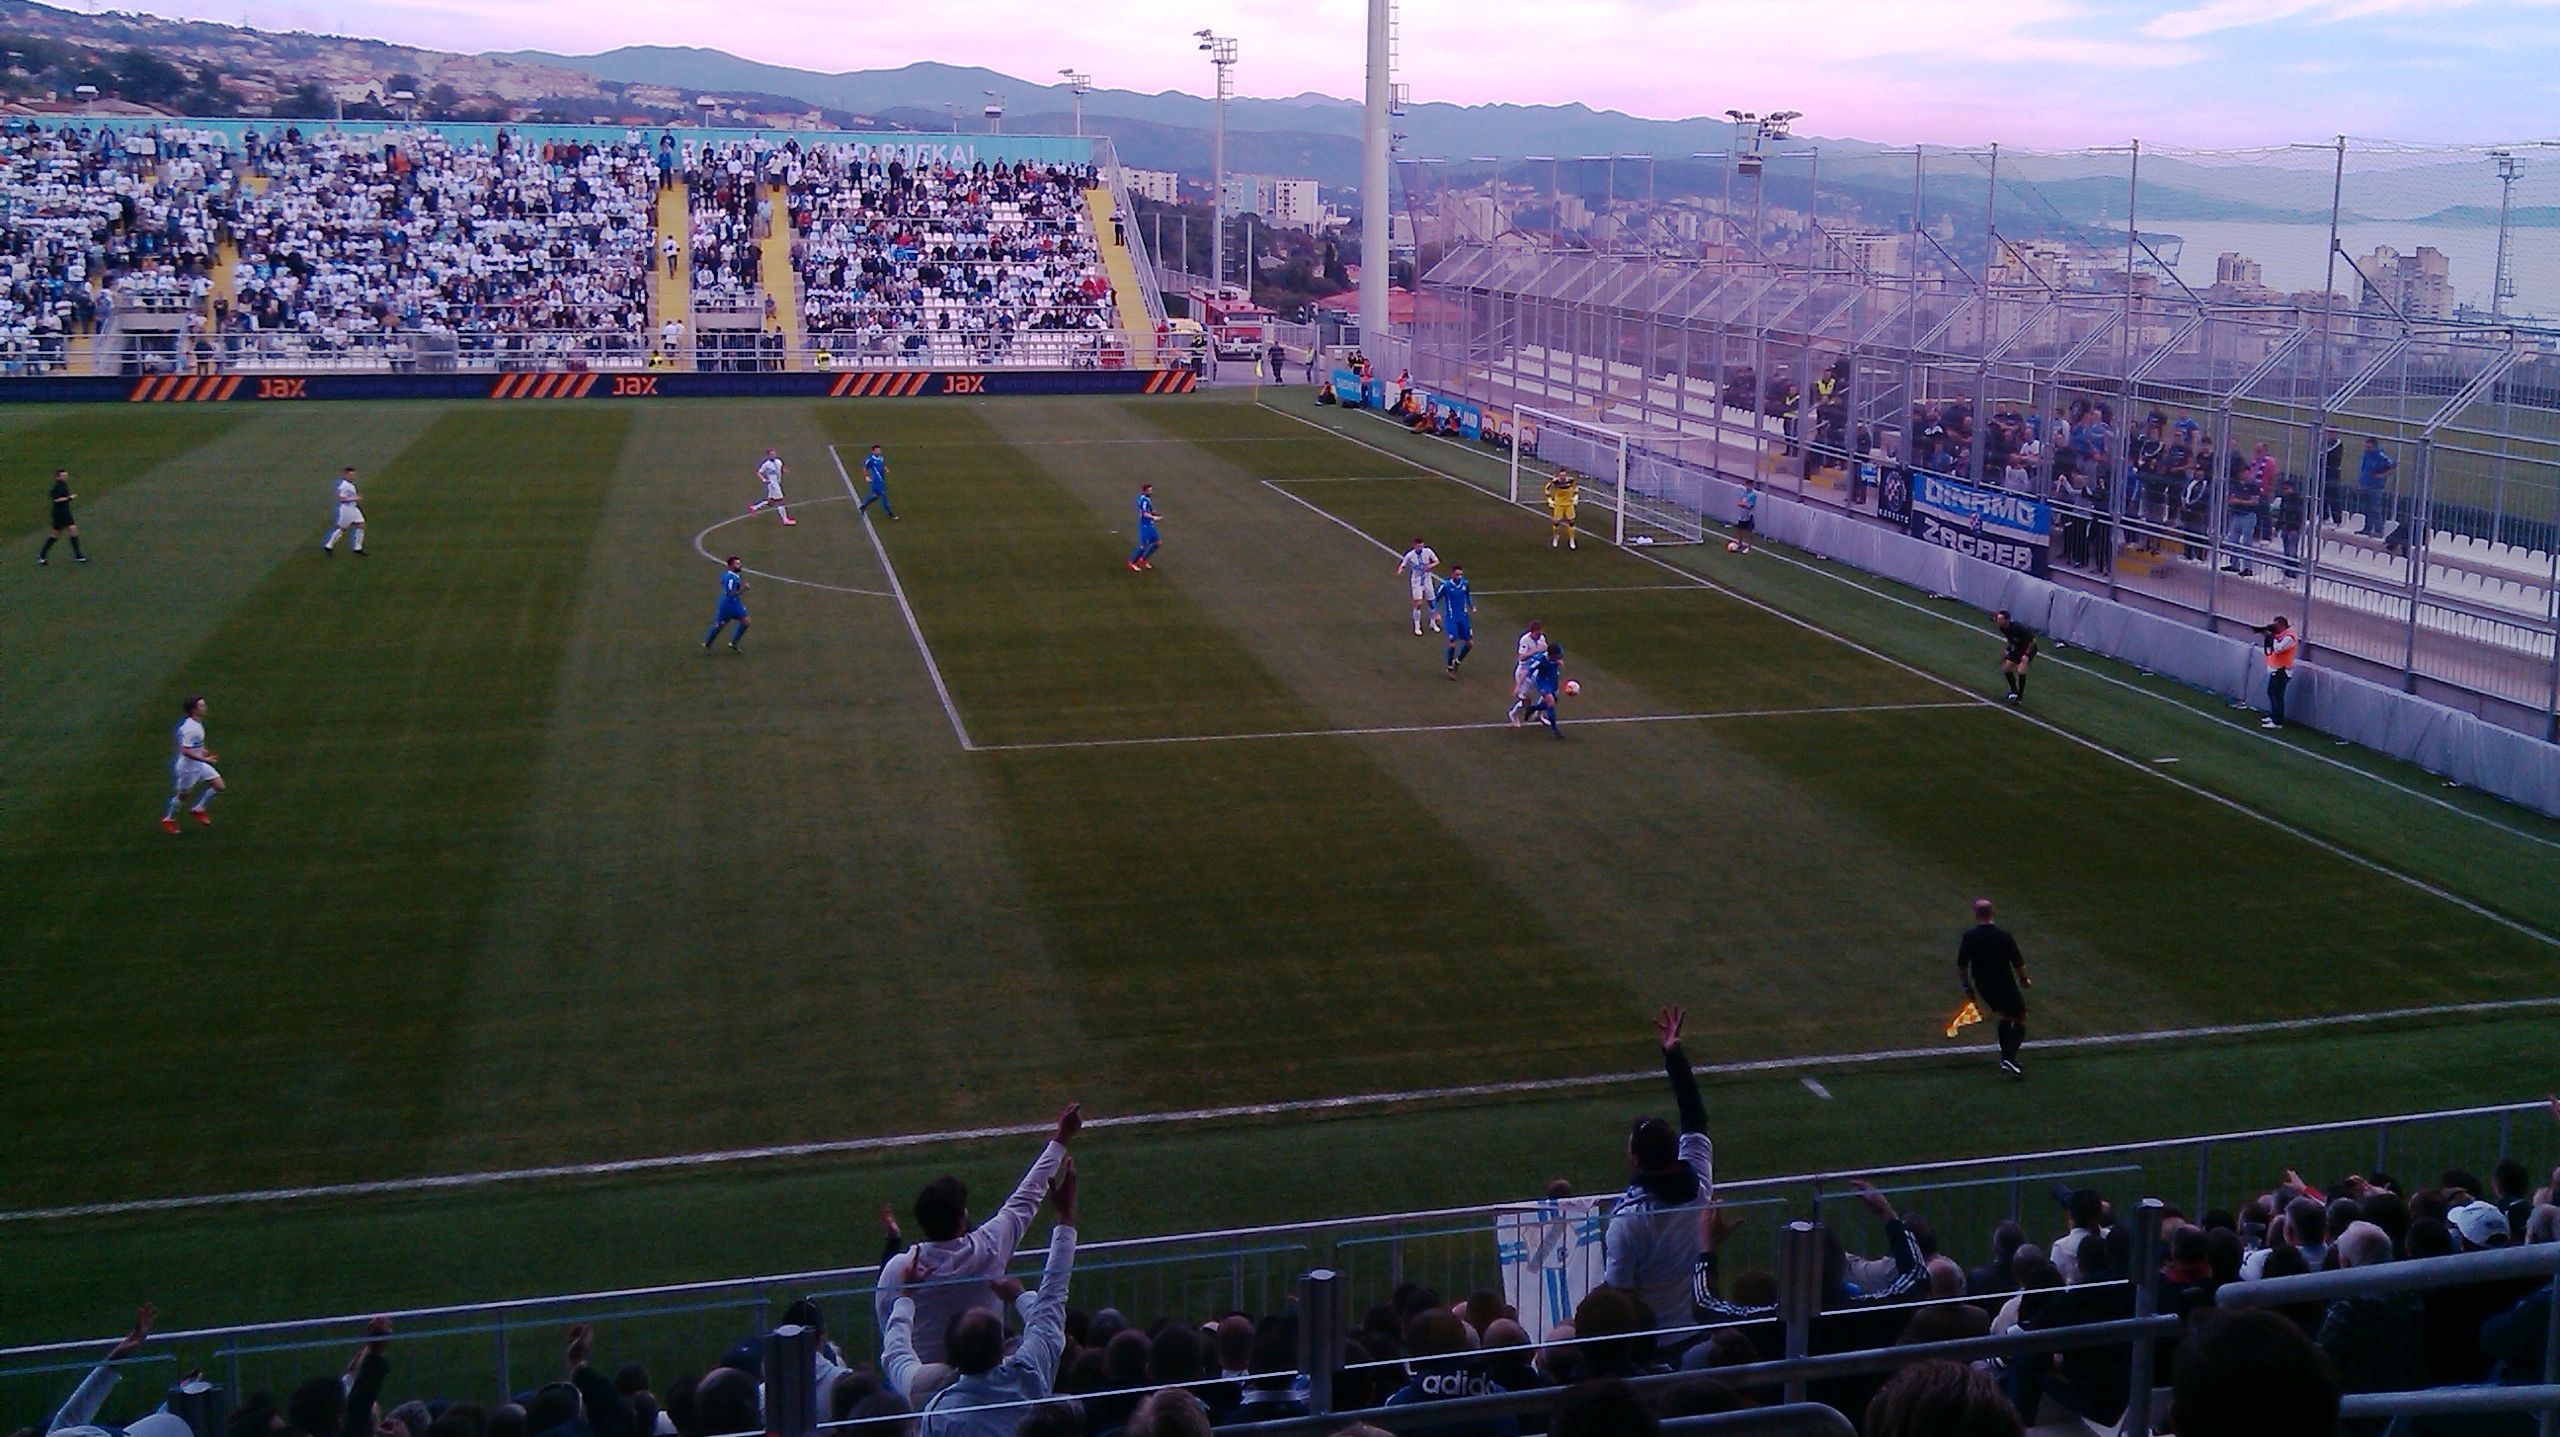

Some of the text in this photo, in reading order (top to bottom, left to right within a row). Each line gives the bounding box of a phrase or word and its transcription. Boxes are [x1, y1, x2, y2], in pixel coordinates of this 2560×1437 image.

[881, 143, 974, 165] RJEKA!
[1925, 477, 2035, 528] DINAMO
[1922, 516, 2034, 572] ZAGREB
